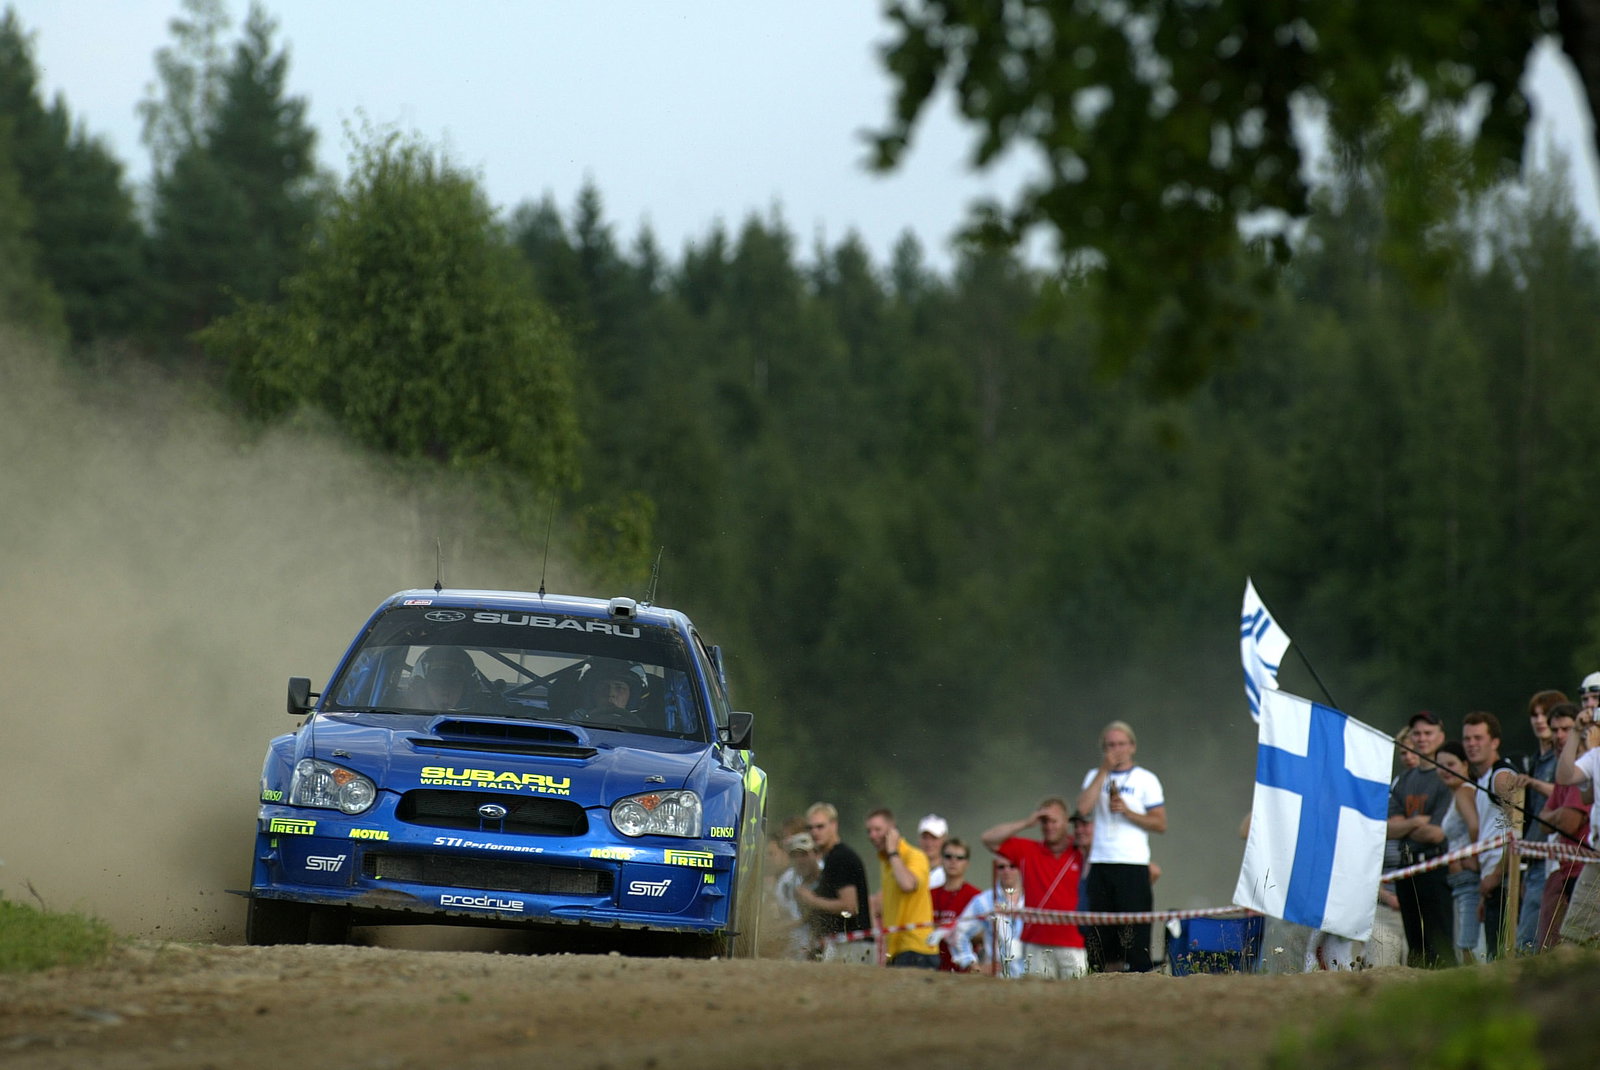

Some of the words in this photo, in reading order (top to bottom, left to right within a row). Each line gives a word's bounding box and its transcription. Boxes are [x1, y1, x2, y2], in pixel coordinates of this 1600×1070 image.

[472, 612, 641, 638] SUBARU
[420, 766, 571, 789] SUBARU
[420, 778, 471, 787] WORLD
[477, 781, 523, 791] RALLY
[529, 785, 570, 795] TEAM
[270, 818, 317, 835] PIRELLI
[348, 828, 390, 841] MOTUL
[710, 826, 734, 838] DENSO
[433, 837, 463, 848] STI
[463, 841, 544, 853] Performance
[664, 849, 714, 868] PIRELLI
[440, 894, 524, 911] prodrive
